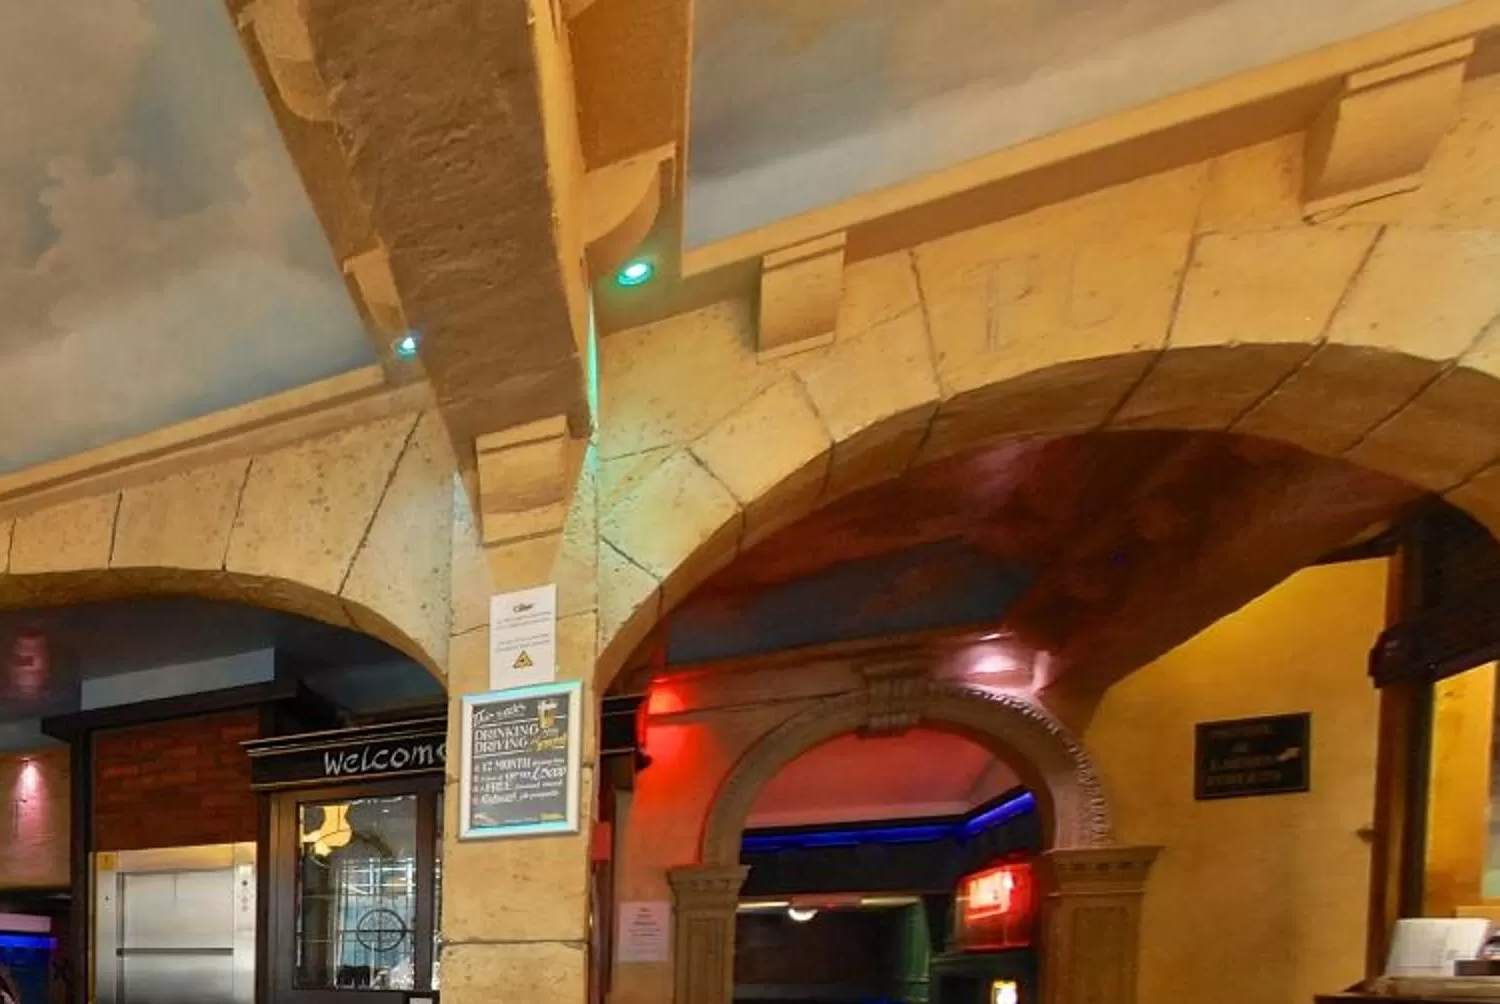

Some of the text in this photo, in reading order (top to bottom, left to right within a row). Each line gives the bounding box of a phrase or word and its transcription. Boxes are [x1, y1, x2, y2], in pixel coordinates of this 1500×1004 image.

[475, 723, 540, 741] DRINKING
[475, 738, 529, 753] DRIVING
[495, 757, 531, 770] MONTH
